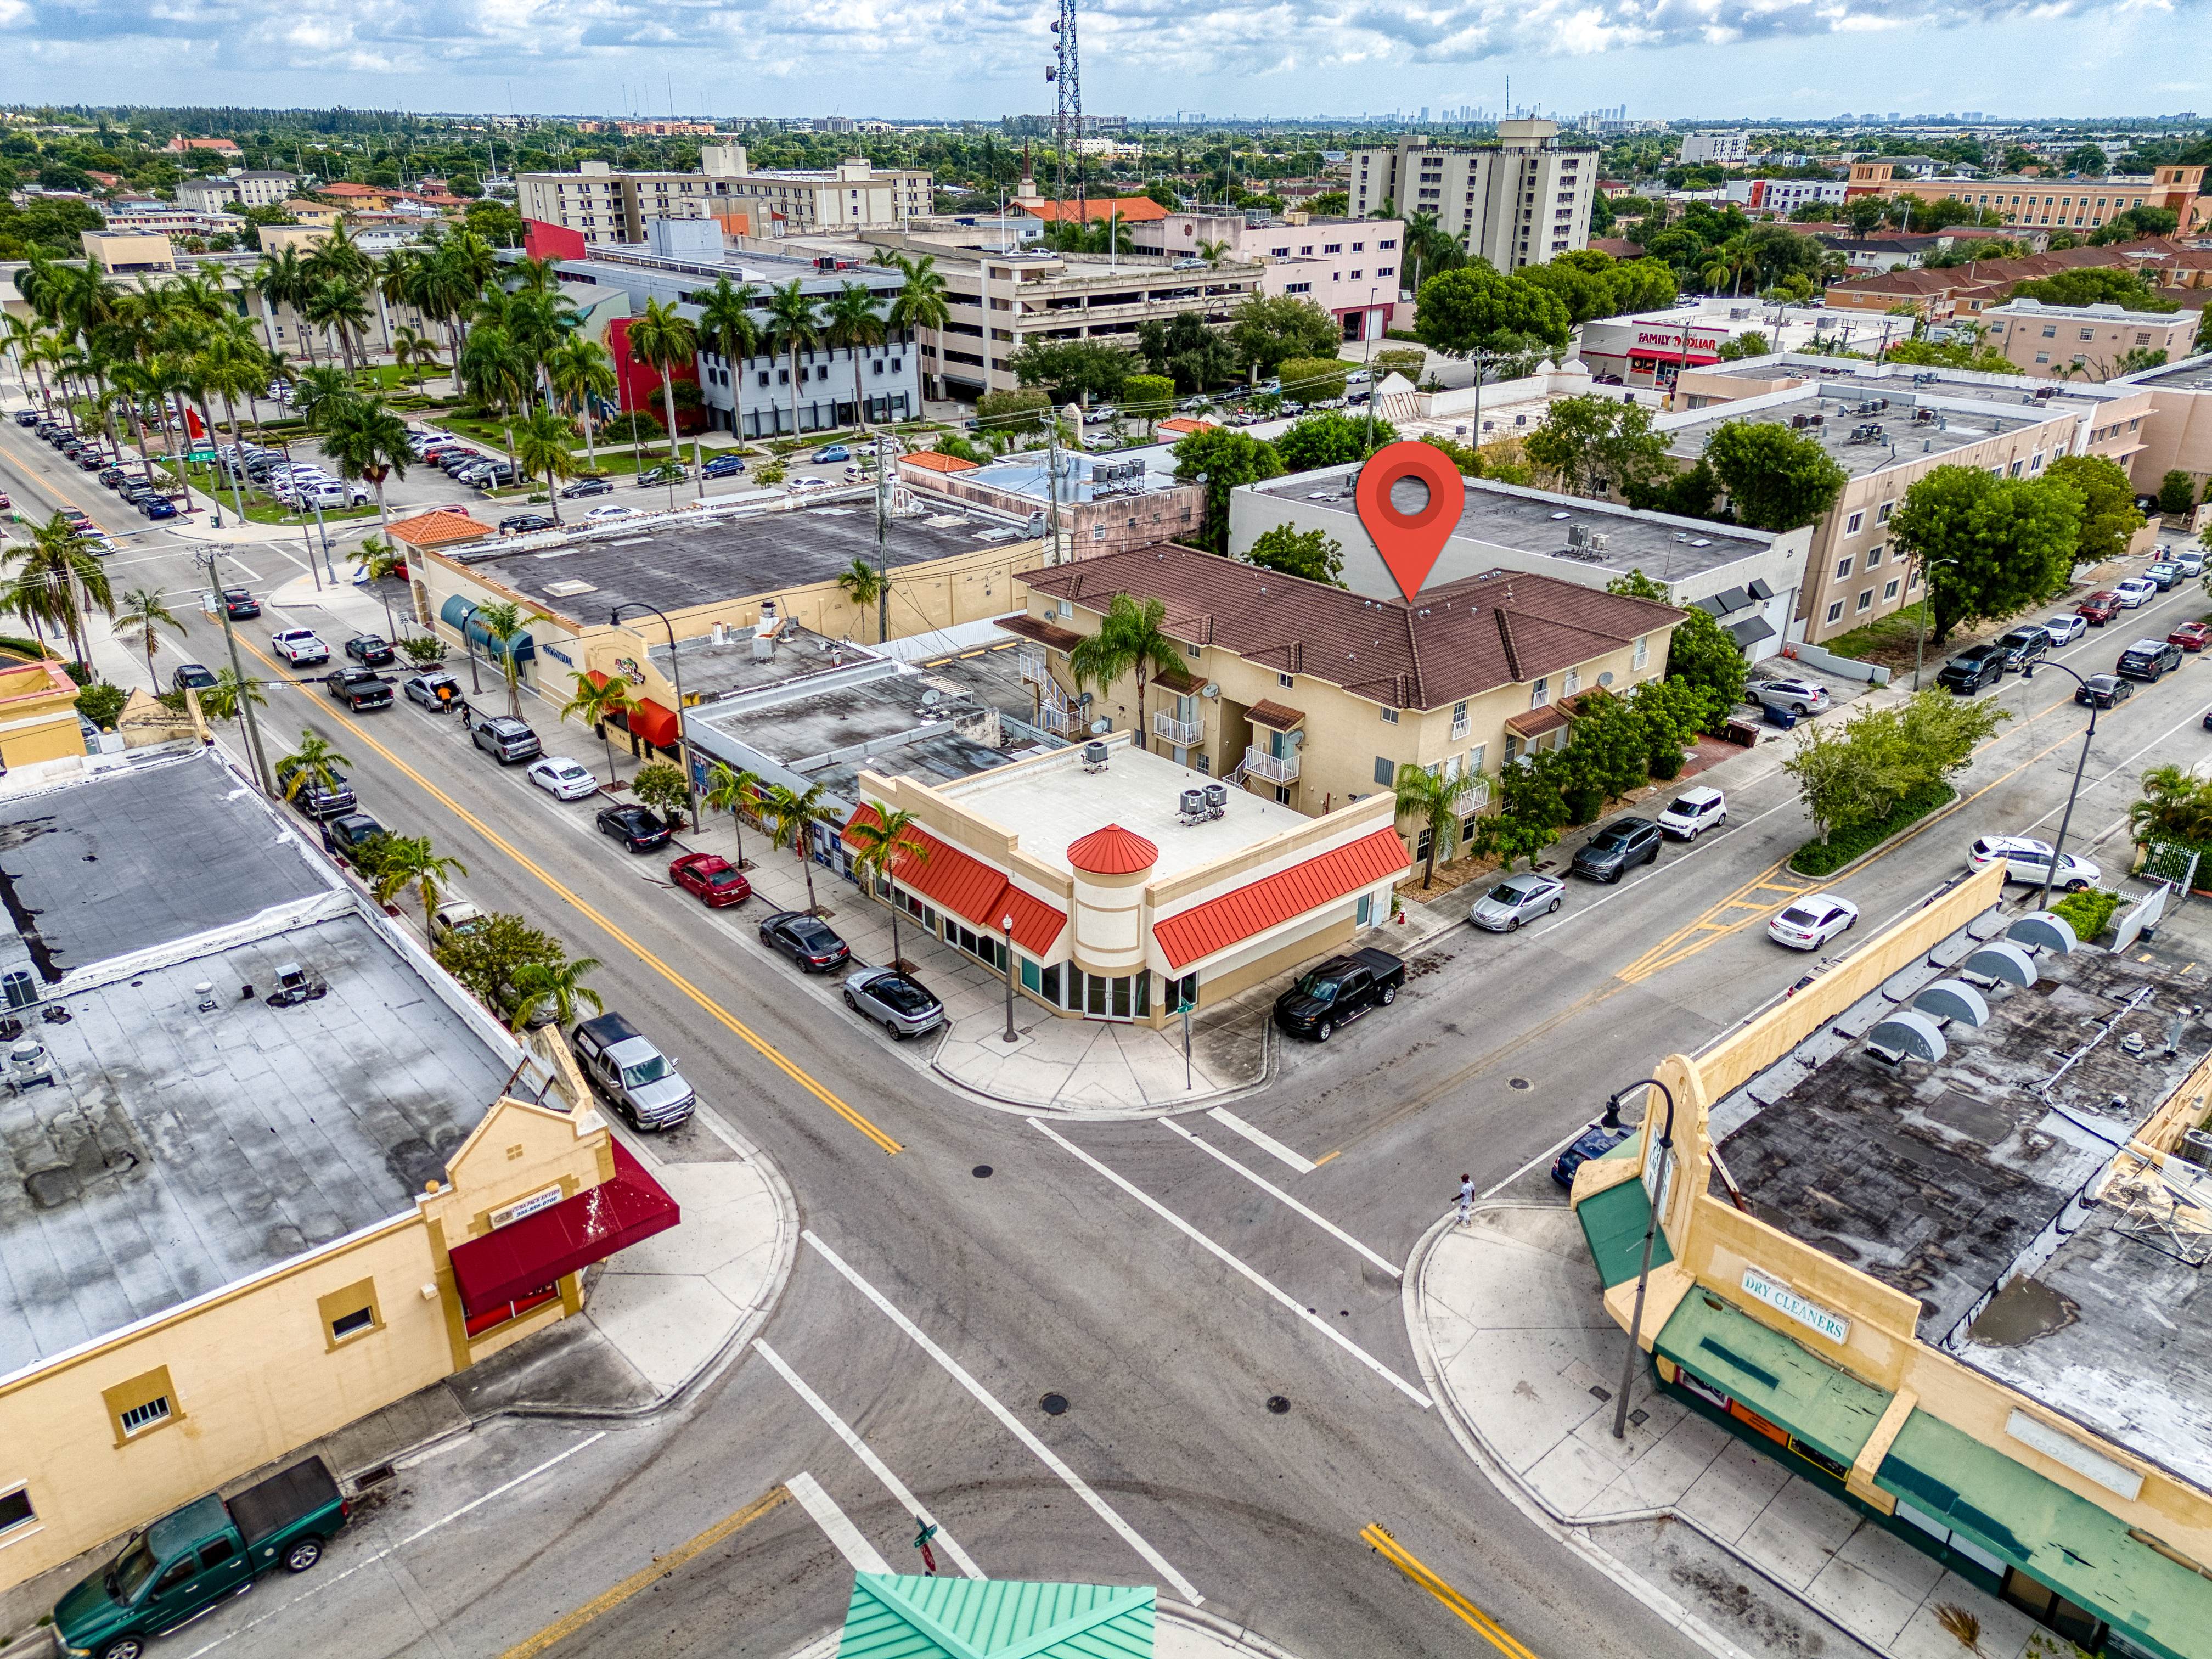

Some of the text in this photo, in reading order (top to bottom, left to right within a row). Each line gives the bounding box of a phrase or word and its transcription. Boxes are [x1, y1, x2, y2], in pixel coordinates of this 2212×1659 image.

[1638, 333, 1671, 345] FAMILY
[543, 644, 574, 668] GOODWILL
[527, 1197, 540, 1207] PACK
[1745, 1276, 1843, 1338] DRY CLEANERS
